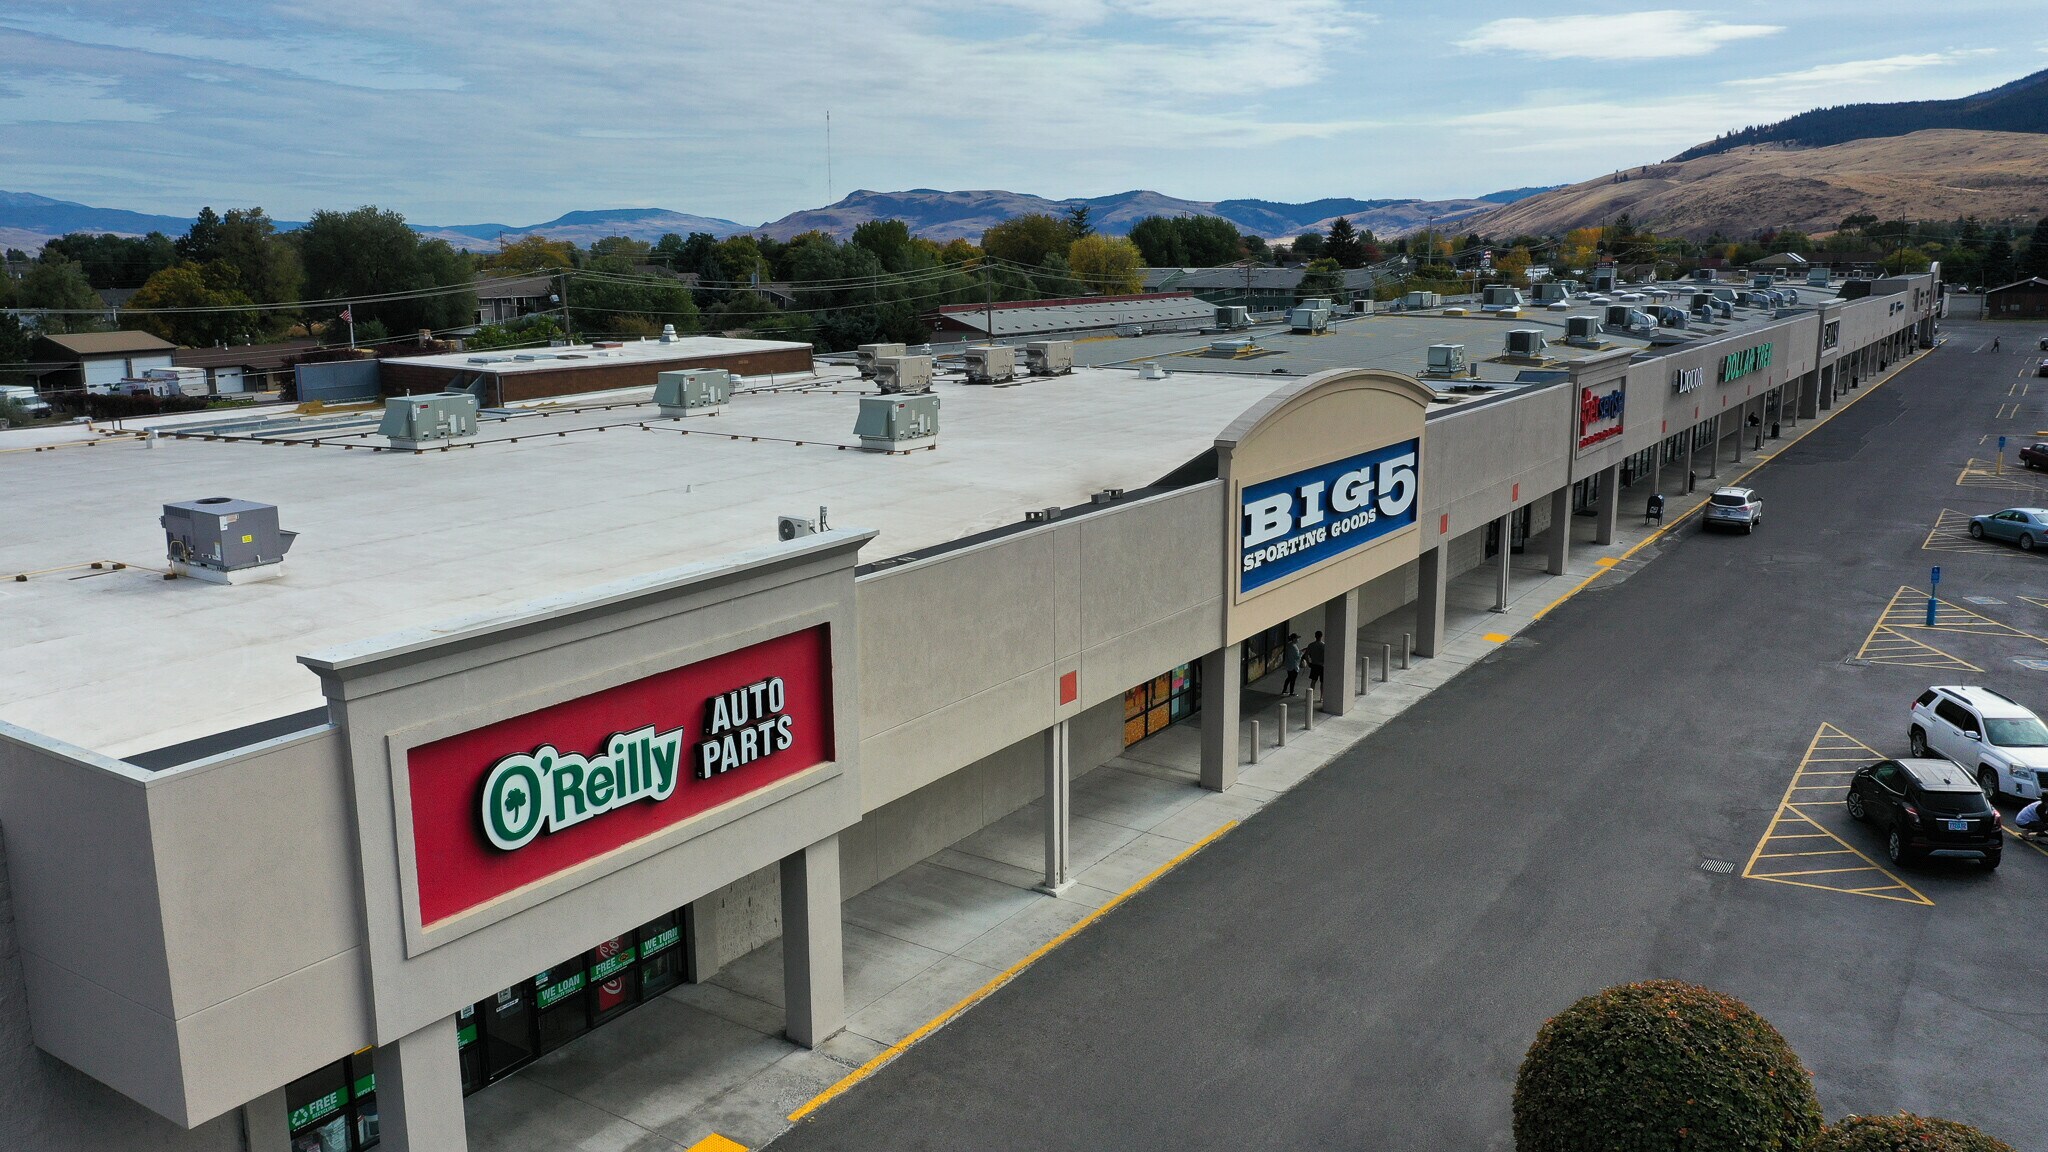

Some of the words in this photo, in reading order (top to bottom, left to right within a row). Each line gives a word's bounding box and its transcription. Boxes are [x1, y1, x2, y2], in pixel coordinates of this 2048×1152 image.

[1725, 348, 1756, 382] DOLLAR
[1756, 342, 1773, 371] TREE
[1244, 467, 1375, 548] BIG
[1377, 452, 1416, 516] 5
[1244, 527, 1326, 572] SPORTING
[1331, 508, 1376, 537] GOODS
[711, 677, 784, 735] AUTO
[702, 715, 792, 779] PARTS
[488, 735, 677, 843] O'Reilly
[644, 937, 657, 950] WE
[658, 927, 678, 944] TURN
[541, 985, 556, 1000] WE
[558, 974, 580, 993] LOAN
[595, 957, 616, 975] FREE
[308, 1091, 337, 1114] FREE
